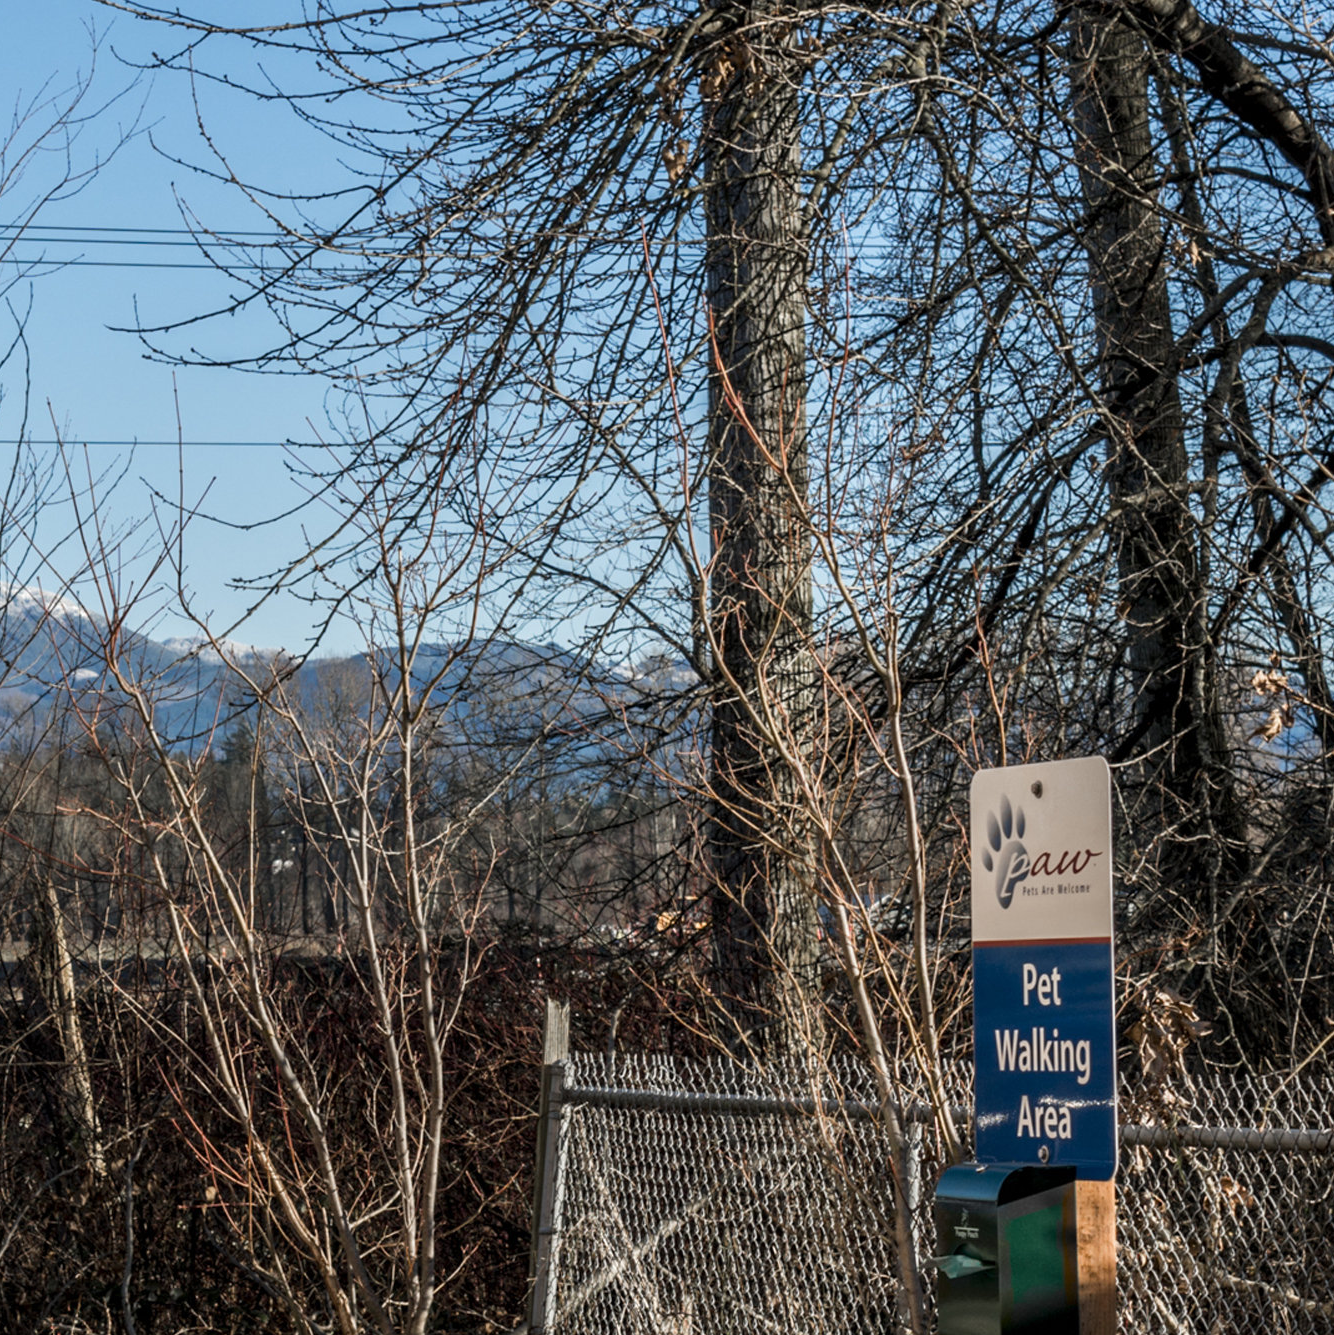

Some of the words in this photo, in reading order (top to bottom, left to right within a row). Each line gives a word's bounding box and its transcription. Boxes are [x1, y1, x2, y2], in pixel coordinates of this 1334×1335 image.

[1000, 849, 1103, 898] paw
[1022, 886, 1039, 896] Pets
[1042, 885, 1054, 895] Are
[1058, 883, 1090, 894] Welcome
[1023, 963, 1062, 1006] Pet
[995, 1027, 1091, 1085] Walking
[1017, 1095, 1072, 1139] Area
